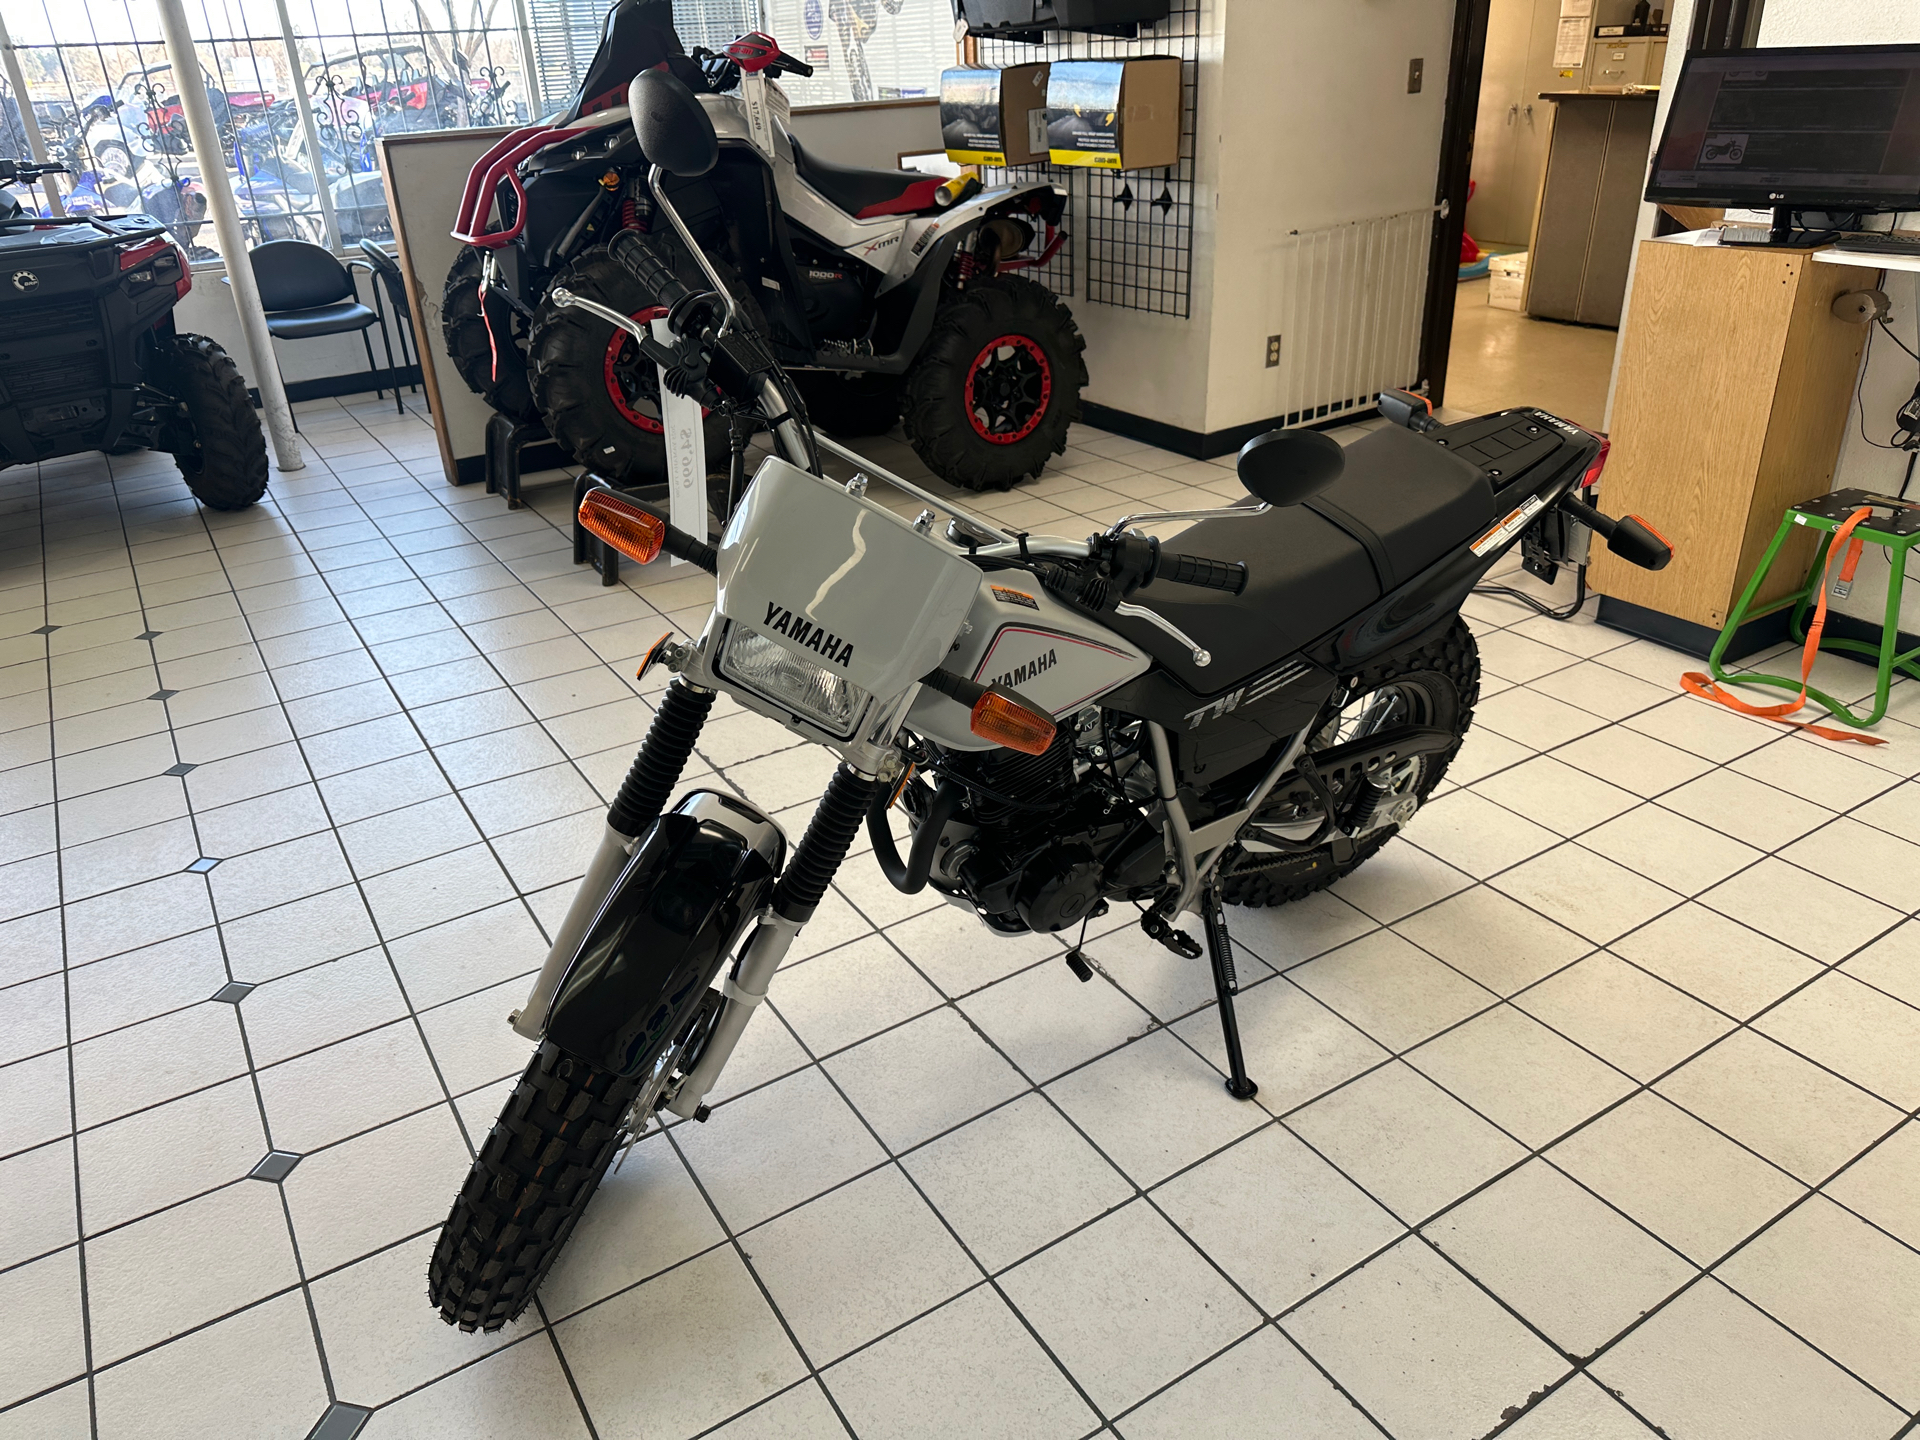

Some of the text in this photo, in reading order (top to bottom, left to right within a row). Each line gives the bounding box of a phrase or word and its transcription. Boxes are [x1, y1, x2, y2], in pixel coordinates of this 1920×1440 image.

[809, 270, 843, 279] 1000R
[1534, 411, 1579, 435] YAMAHA
[763, 601, 854, 668] YAMAHA
[1183, 687, 1246, 730] TW
